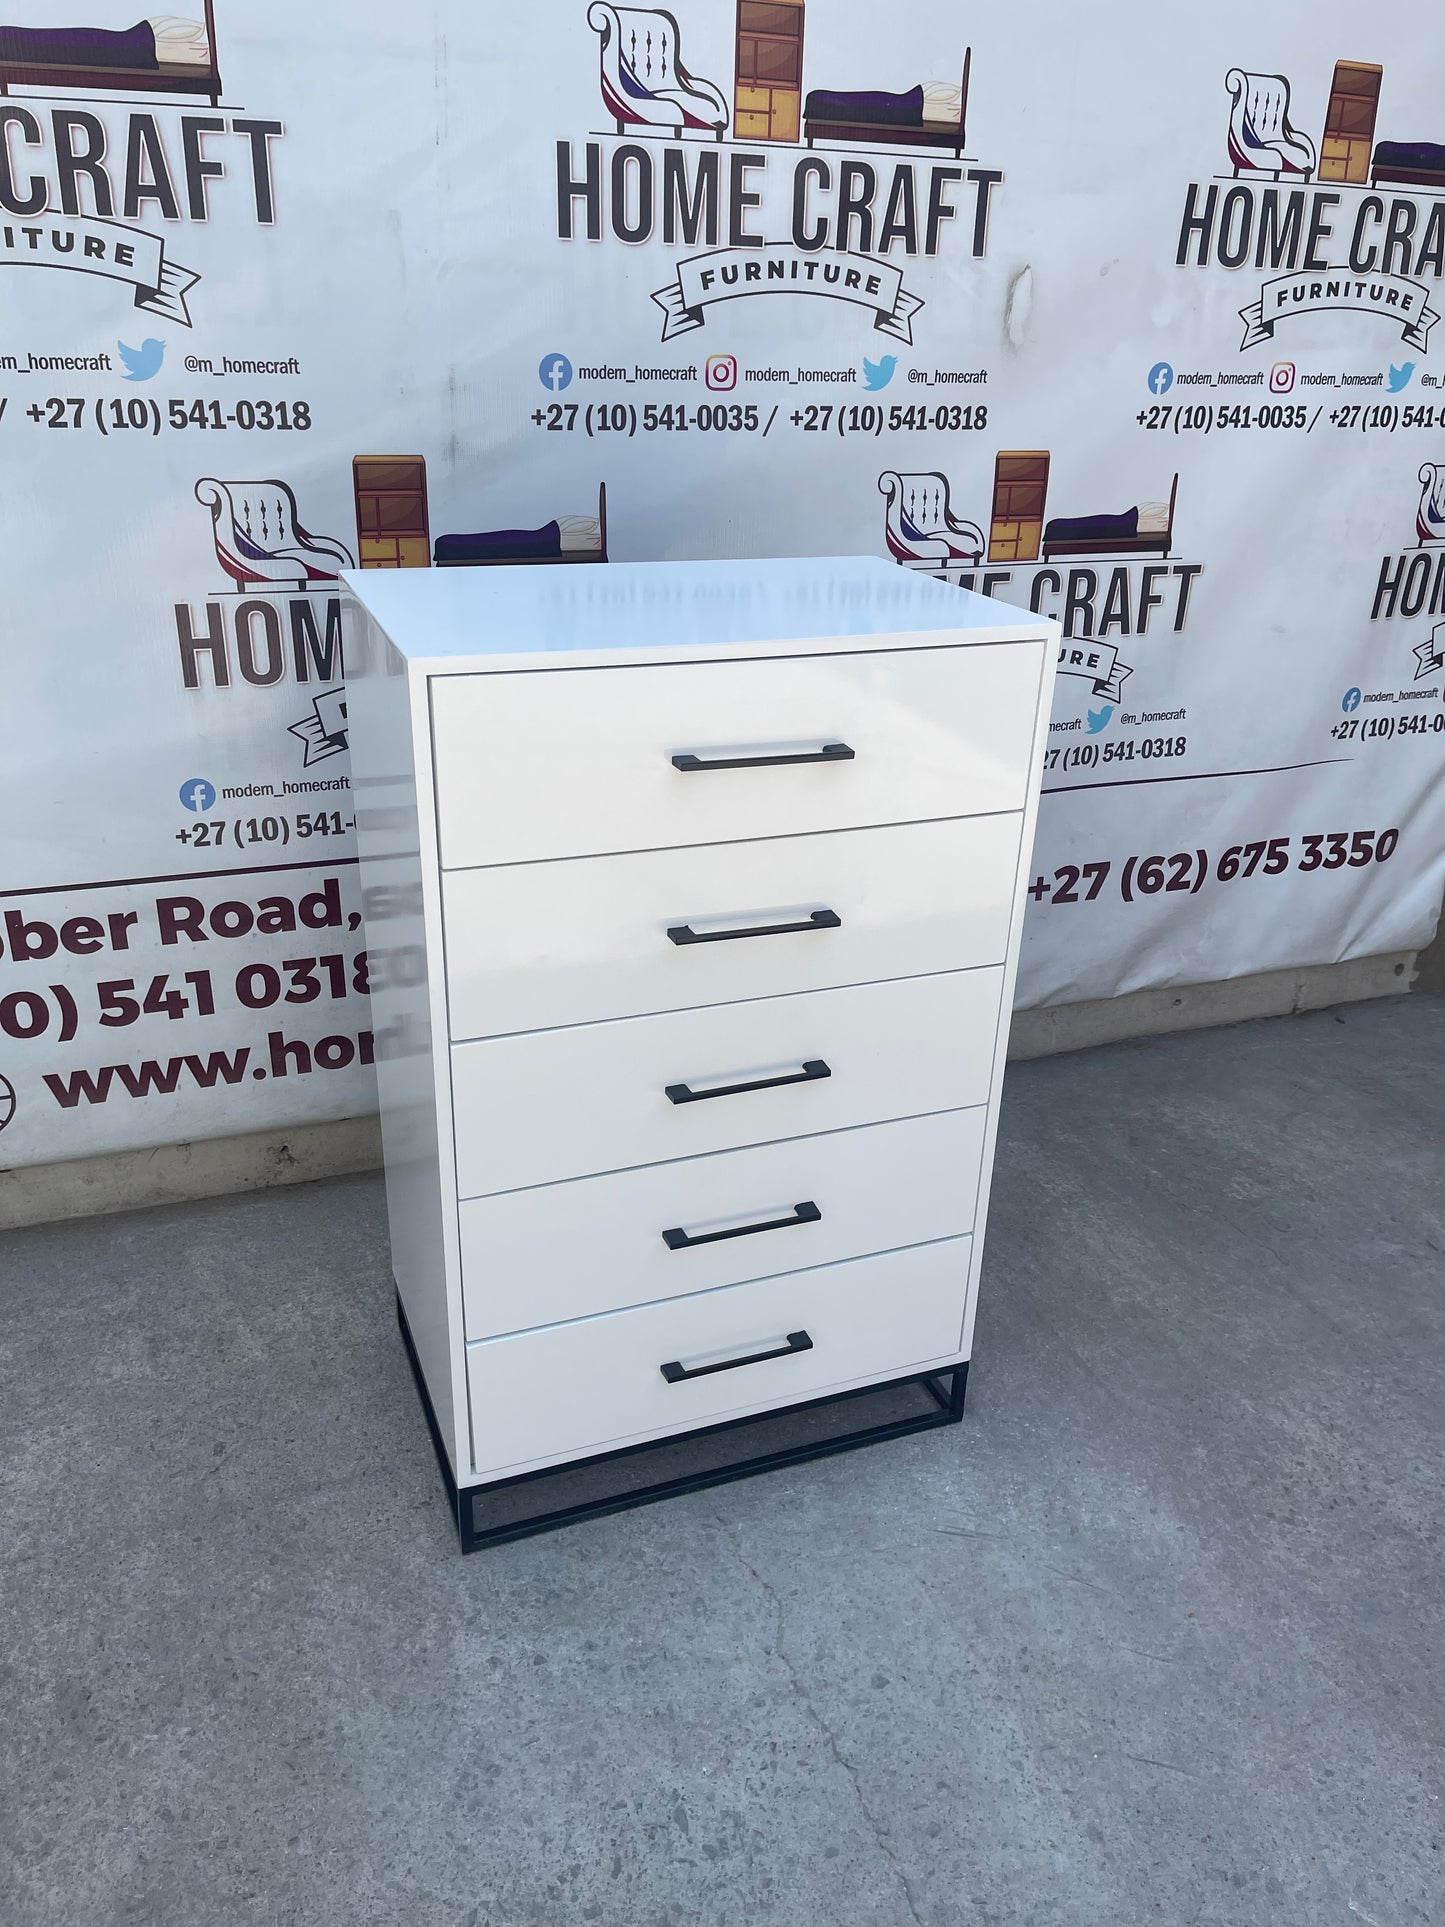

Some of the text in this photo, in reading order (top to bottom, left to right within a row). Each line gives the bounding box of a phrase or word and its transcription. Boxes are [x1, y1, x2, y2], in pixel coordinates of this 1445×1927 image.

[0, 105, 284, 226] CRAFT
[556, 139, 1003, 260] HOME CRAFT
[1175, 182, 1341, 272] HOME
[701, 260, 881, 297] FURNITURE
[1277, 280, 1414, 312] FURNITURE
[184, 355, 300, 376] @m_homecraft
[578, 364, 697, 383] modern_homecraft
[745, 368, 857, 384] modern_homecraft
[908, 368, 988, 386] @m_homecraft
[1177, 371, 1264, 388] modern_homecraft
[1301, 372, 1383, 389] modern_homecraft
[26, 398, 85, 428] +27
[95, 398, 161, 436] (10)
[168, 398, 311, 431] 541-0318
[531, 404, 579, 431] +27
[585, 404, 637, 437] (10)
[642, 404, 759, 431] 541-0035
[790, 405, 833, 431] +27
[838, 405, 884, 437] (10)
[888, 405, 988, 431] 541-0318
[1136, 406, 1172, 430] +27
[1174, 405, 1213, 434] (10)
[1216, 405, 1306, 429] 541-0035
[1329, 405, 1361, 429] +27
[1362, 405, 1398, 432] (10)
[1030, 564, 1202, 638] CRAFT
[1363, 688, 1439, 704] modern_homecraft
[1120, 708, 1186, 727] @m_homecraft
[1330, 713, 1445, 742] +27 (10) 541-0
[1063, 745, 1099, 772] (10)
[1102, 736, 1187, 763] 541-0318
[222, 777, 351, 799] modern_homecraft
[176, 811, 357, 848] +27 (10) 541-
[1028, 828, 1399, 905] +27 (62) 675 3350
[0, 910, 138, 962] ber
[156, 878, 362, 946] Road,
[97, 970, 215, 1027] 541
